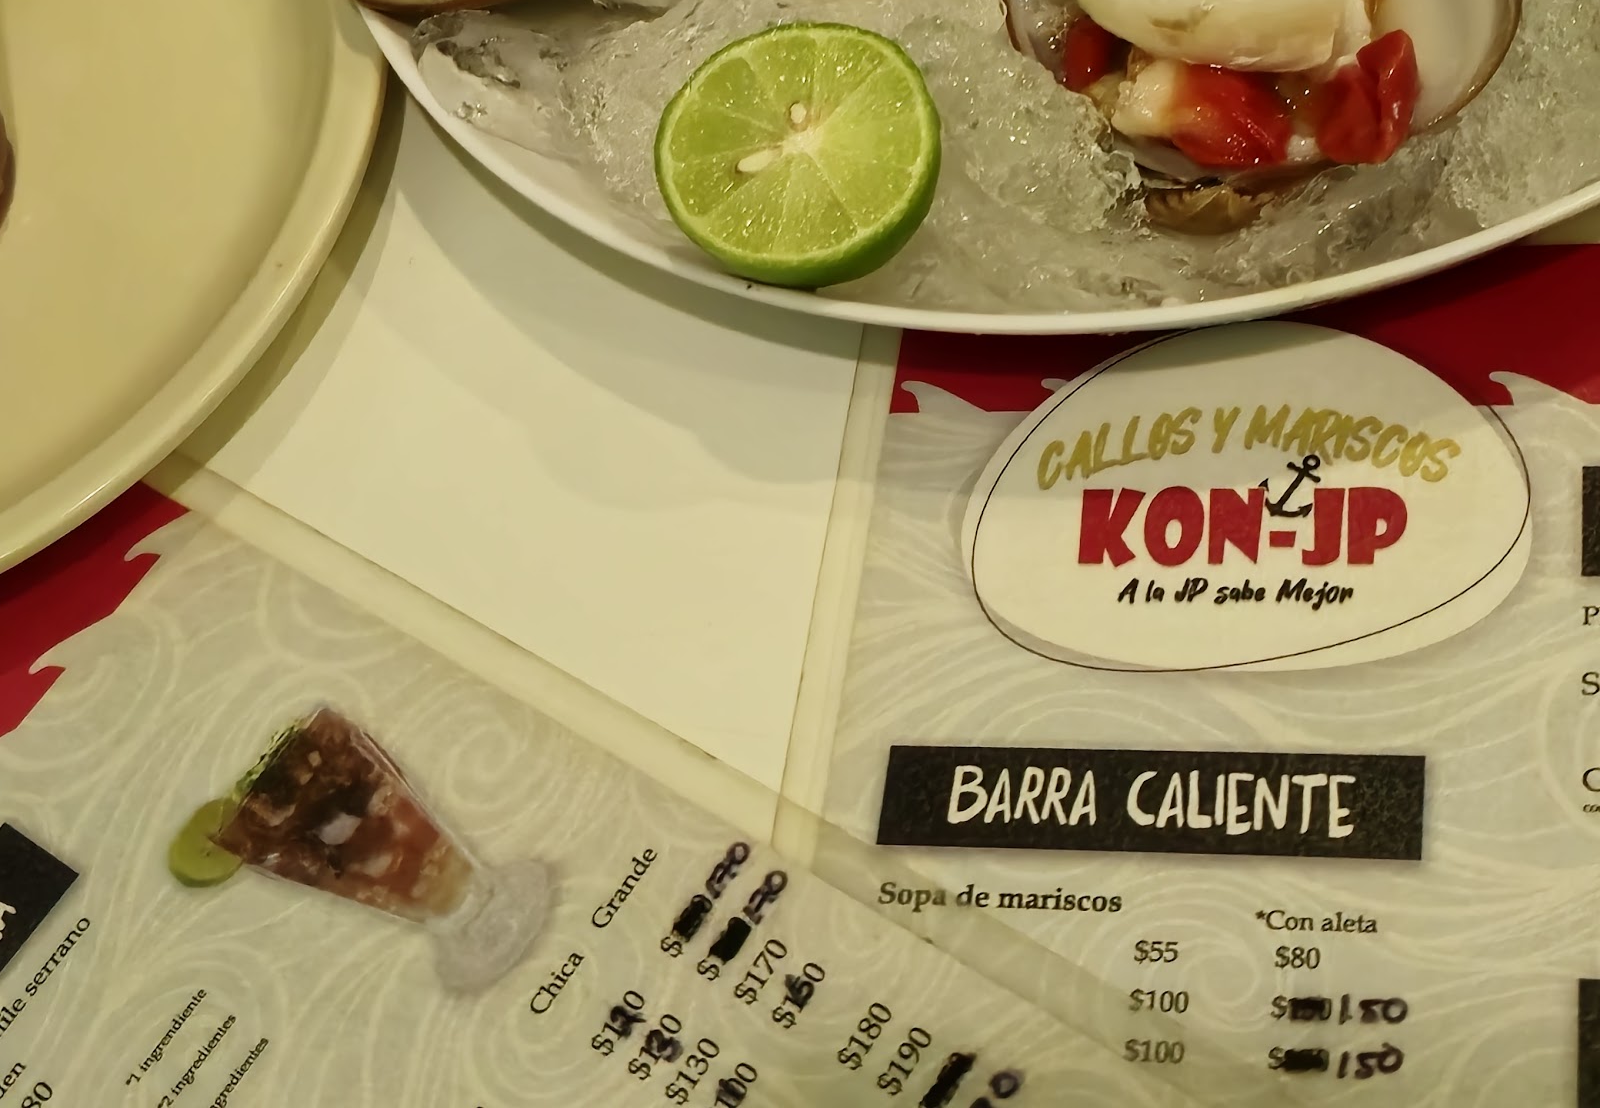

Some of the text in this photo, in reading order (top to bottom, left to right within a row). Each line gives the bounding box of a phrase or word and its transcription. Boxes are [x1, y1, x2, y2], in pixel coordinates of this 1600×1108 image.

[1036, 403, 1462, 490] CALLOS Y MARISCOS
[1078, 485, 1408, 568] KON-JP
[1118, 577, 1355, 612] A la JP sabe Mejor
[947, 764, 1357, 839] BARRA CALIENTE
[529, 847, 658, 1015] Chica Grande
[877, 881, 1123, 913] Sopa de mariscos
[1321, 910, 1378, 935] aleta
[24, 916, 91, 997] serrano
[734, 939, 788, 1006] $170
[1132, 939, 1321, 972] $55 $80
[837, 1002, 892, 1071] $180
[1128, 989, 1190, 1016] $100
[665, 1037, 720, 1105] $130
[876, 1027, 932, 1096] $190
[1123, 1038, 1186, 1066] $100
